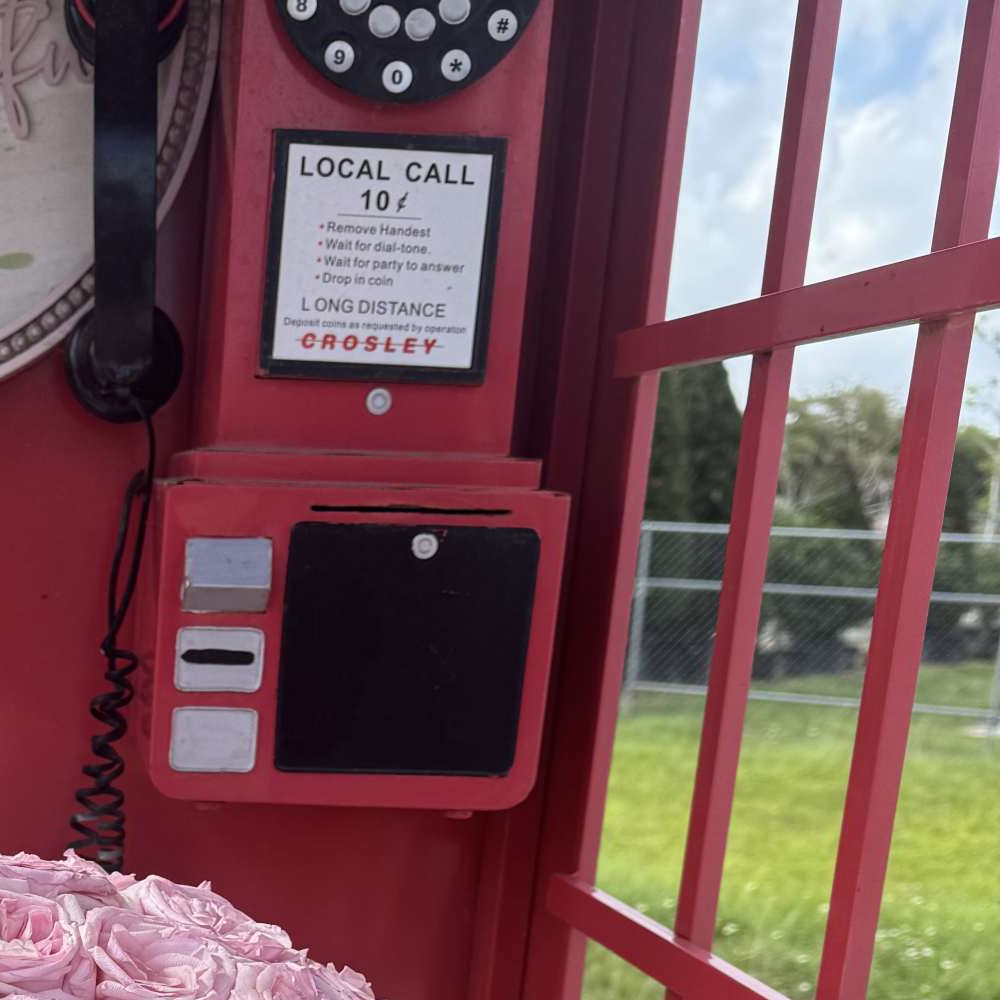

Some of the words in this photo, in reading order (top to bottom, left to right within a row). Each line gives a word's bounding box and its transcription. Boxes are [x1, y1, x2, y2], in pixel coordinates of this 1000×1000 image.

[334, 50, 344, 64] 9
[392, 70, 402, 85] 0
[300, 156, 390, 181] LOCAL
[406, 162, 475, 185] CALL
[327, 222, 376, 235] Remove
[380, 224, 431, 237] Handest
[325, 239, 353, 252] Wait
[355, 240, 372, 253] for
[373, 241, 431, 255] dial-tone.
[324, 256, 352, 269] Wait
[353, 257, 370, 270] for
[373, 260, 402, 272] party
[406, 260, 418, 271] to
[420, 263, 464, 273] answer
[322, 273, 352, 286] Drop
[355, 274, 365, 285] in
[368, 275, 393, 286] coin
[302, 298, 354, 314] LONG
[359, 300, 446, 318] DISTANCE
[284, 317, 319, 328] Deposit
[321, 320, 347, 328] coins
[411, 324, 422, 334] by
[301, 333, 438, 355] CROSLEY
